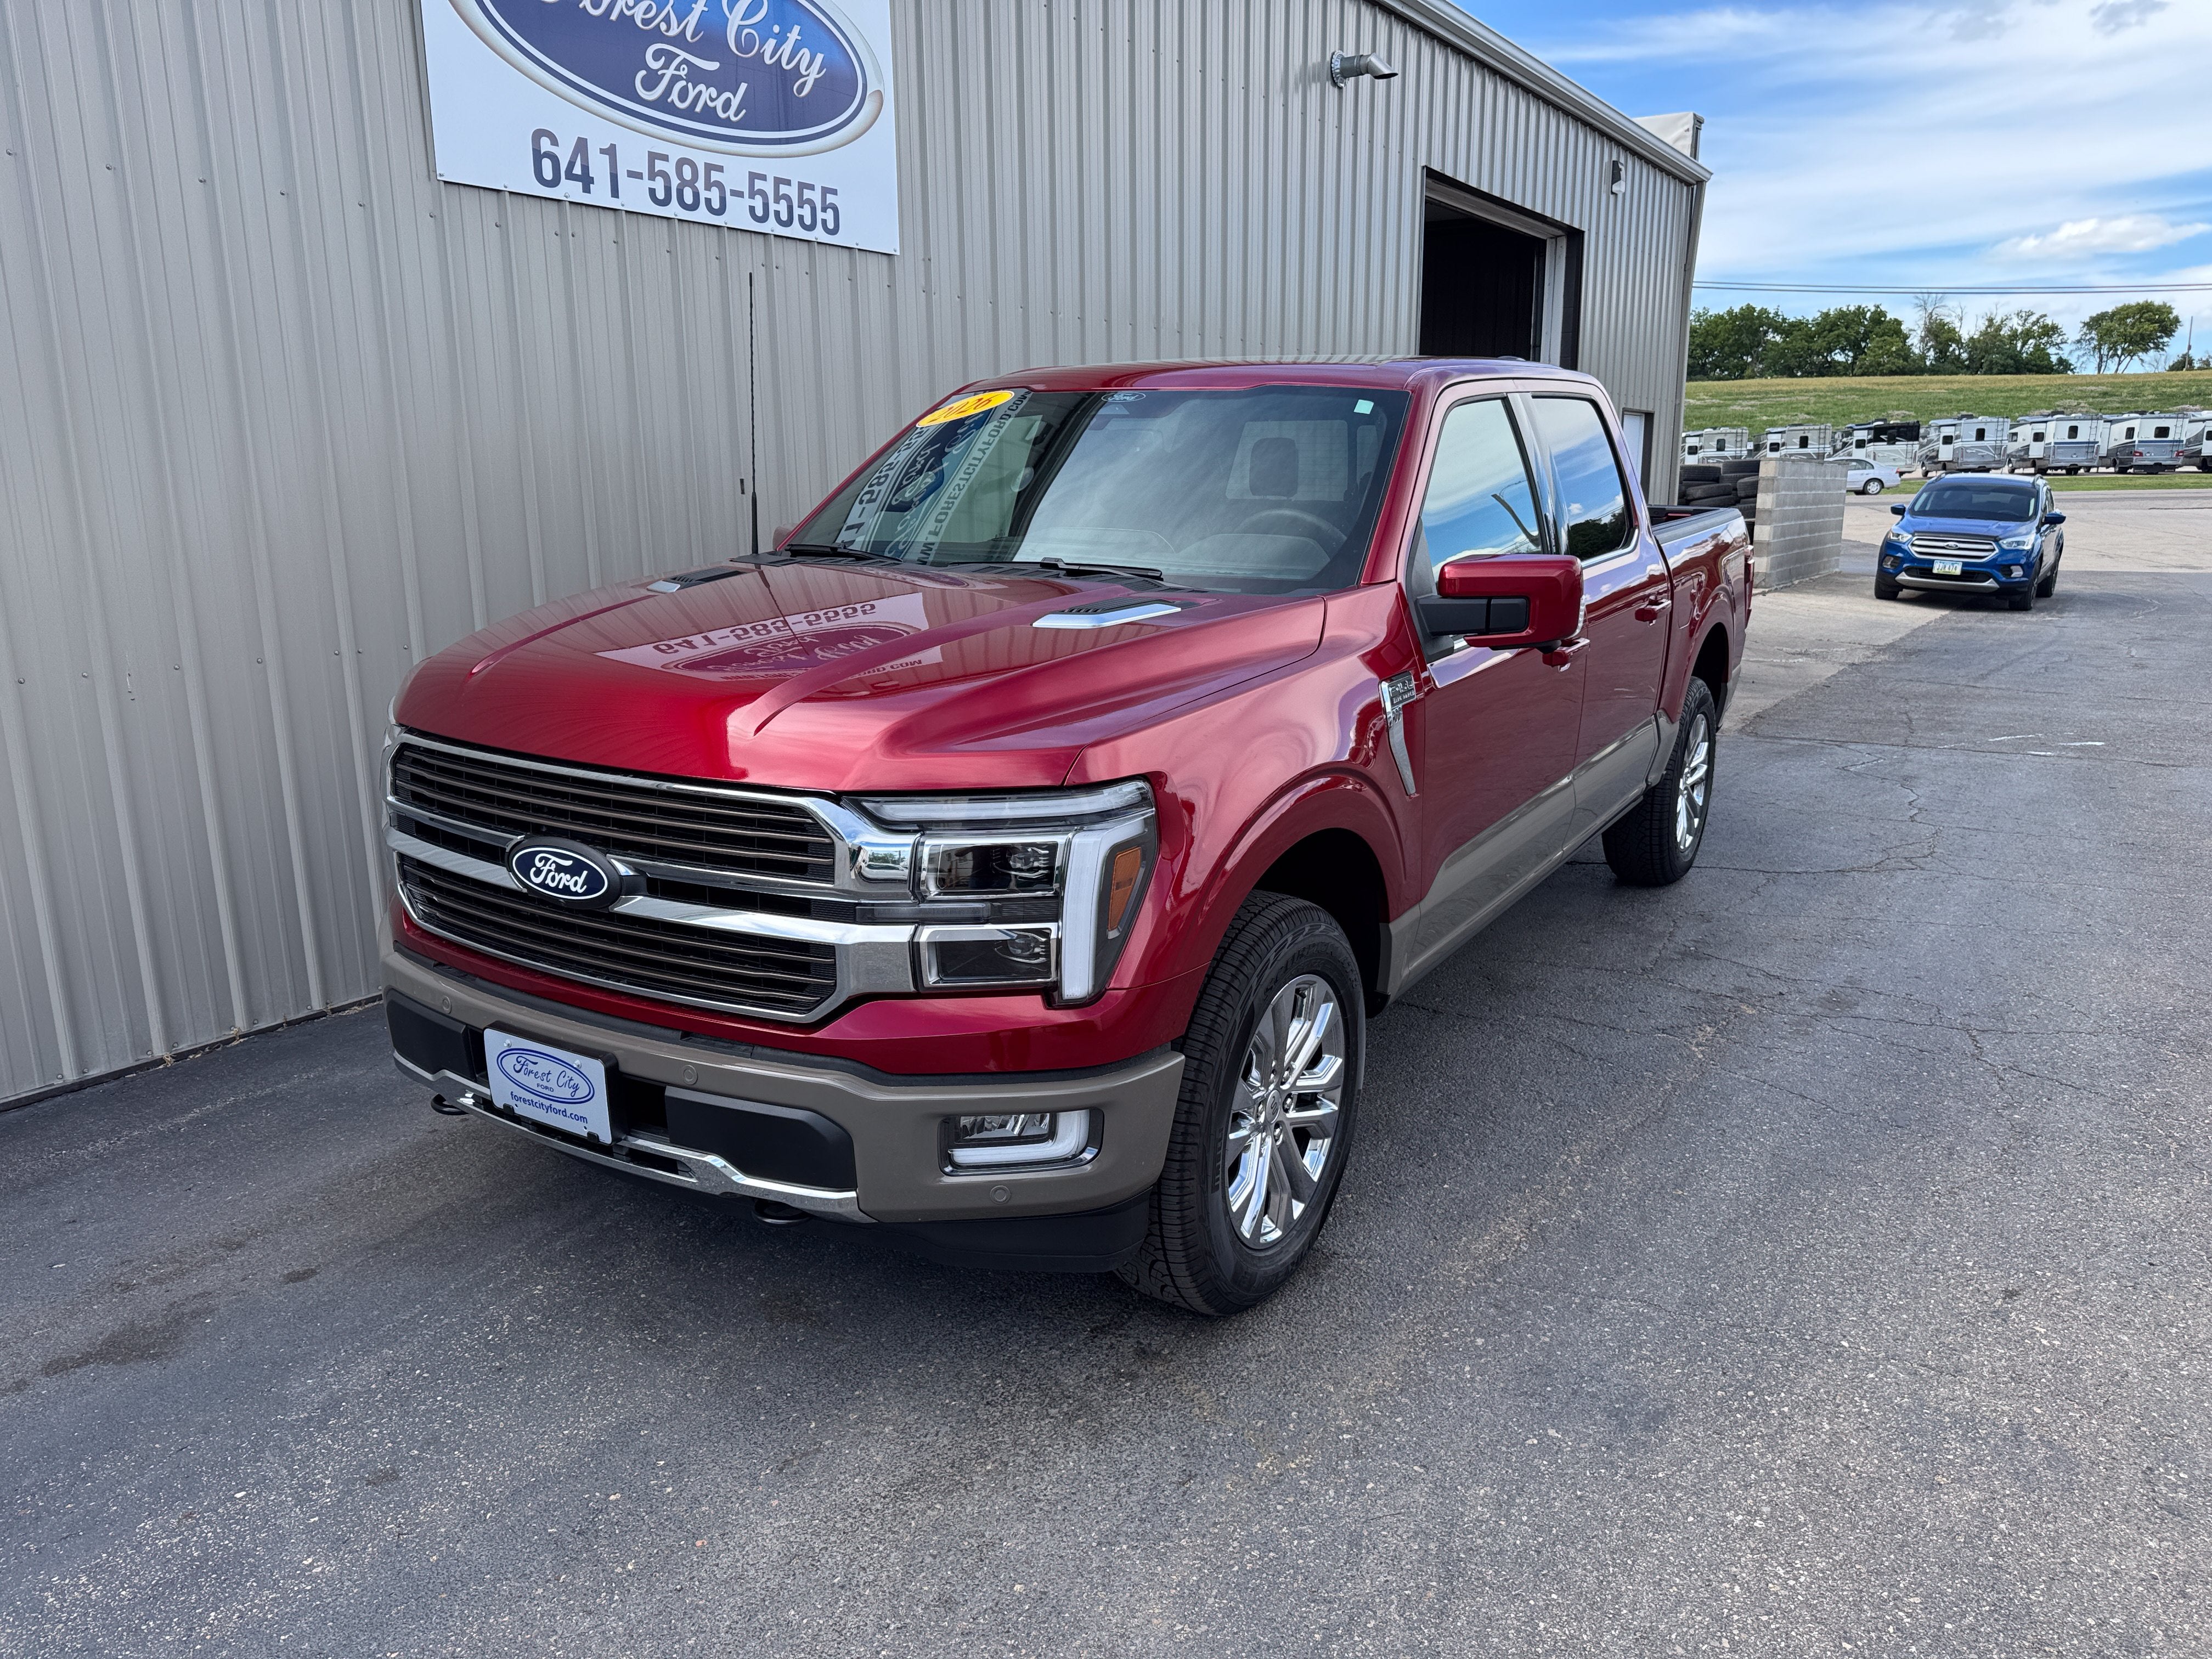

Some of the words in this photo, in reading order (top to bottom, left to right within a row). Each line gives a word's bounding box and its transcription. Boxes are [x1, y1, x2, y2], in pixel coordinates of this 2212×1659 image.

[721, 0, 826, 98] City
[634, 43, 748, 122] Ford
[530, 128, 840, 236] 641-585-5555
[1107, 393, 1139, 401] Ford
[529, 853, 588, 893] Ford
[513, 1056, 552, 1083] Forest
[556, 1070, 580, 1098] City
[536, 1083, 554, 1092] FORD
[510, 1091, 588, 1124] forestcityford.com
